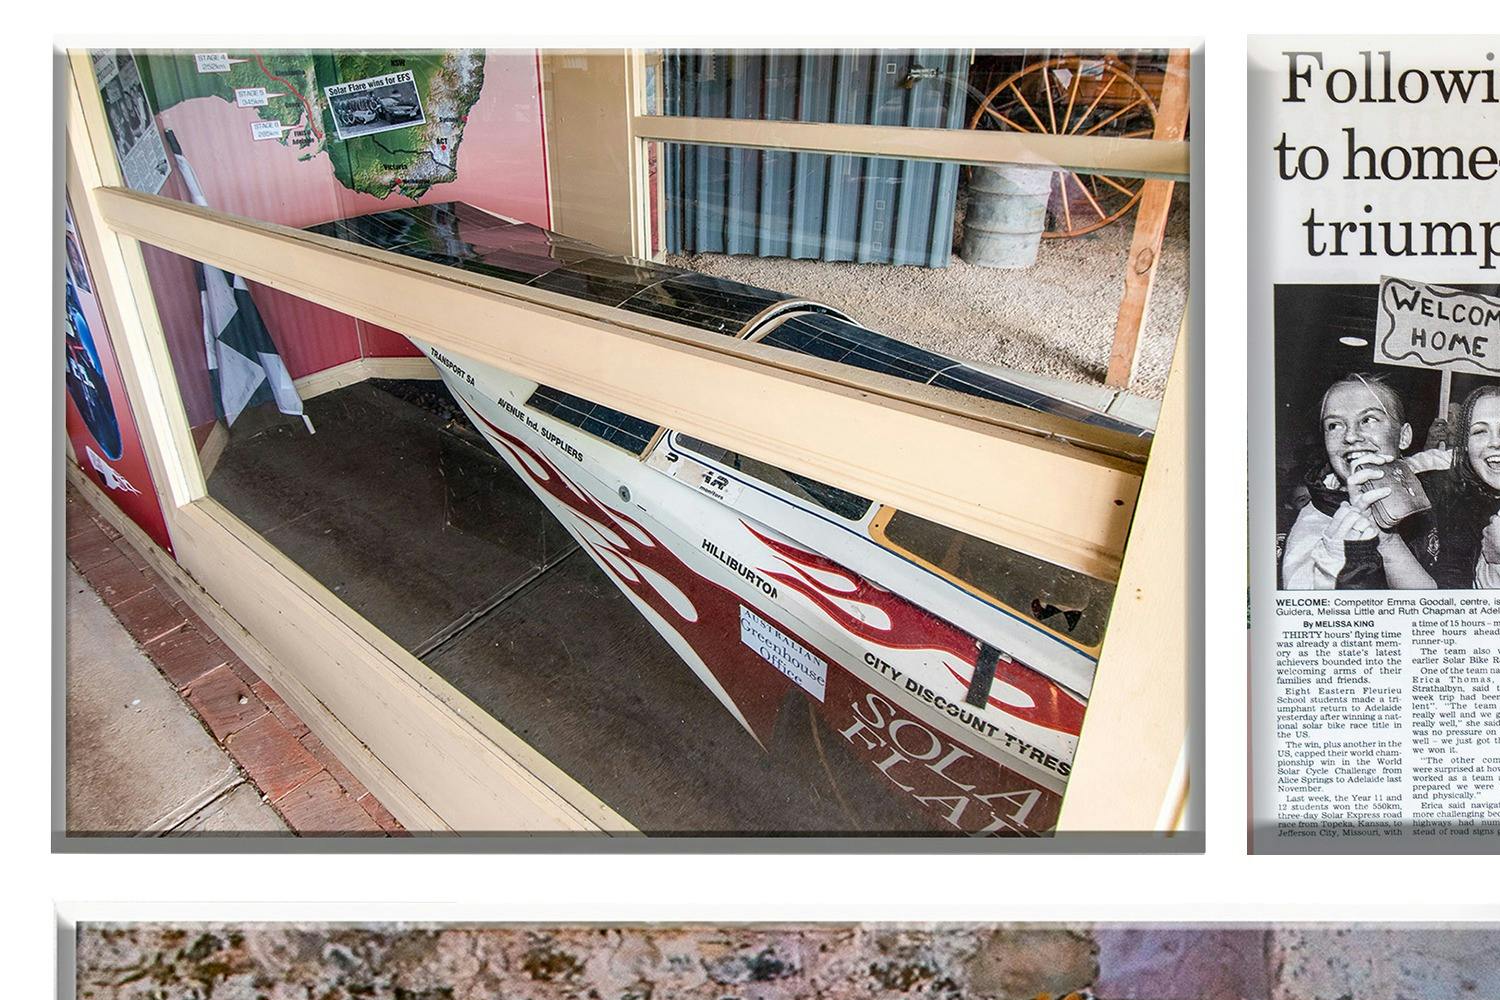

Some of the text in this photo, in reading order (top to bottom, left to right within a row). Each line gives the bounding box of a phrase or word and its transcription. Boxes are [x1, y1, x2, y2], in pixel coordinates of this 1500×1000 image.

[328, 73, 411, 96] Solar Flare wins for EFS
[1273, 132, 1329, 180] to
[1411, 327, 1488, 358] HOME
[430, 347, 476, 387] TRANSPORT SA
[497, 397, 583, 462] AVENUE Ind. SUPPLIERS
[1275, 598, 1330, 606] WELCOME:
[1333, 597, 1383, 608] Competitor
[1386, 597, 1416, 606] Emma
[1419, 597, 1456, 606] Goodall,
[1459, 598, 1490, 606] centre,
[1493, 597, 1500, 605] is
[743, 609, 822, 666] AUSTRALIAN
[1303, 620, 1313, 629] By
[740, 616, 825, 687] Greenhouse
[759, 645, 803, 685] Office
[864, 651, 1071, 776] CITY DISCOUNT TYRES
